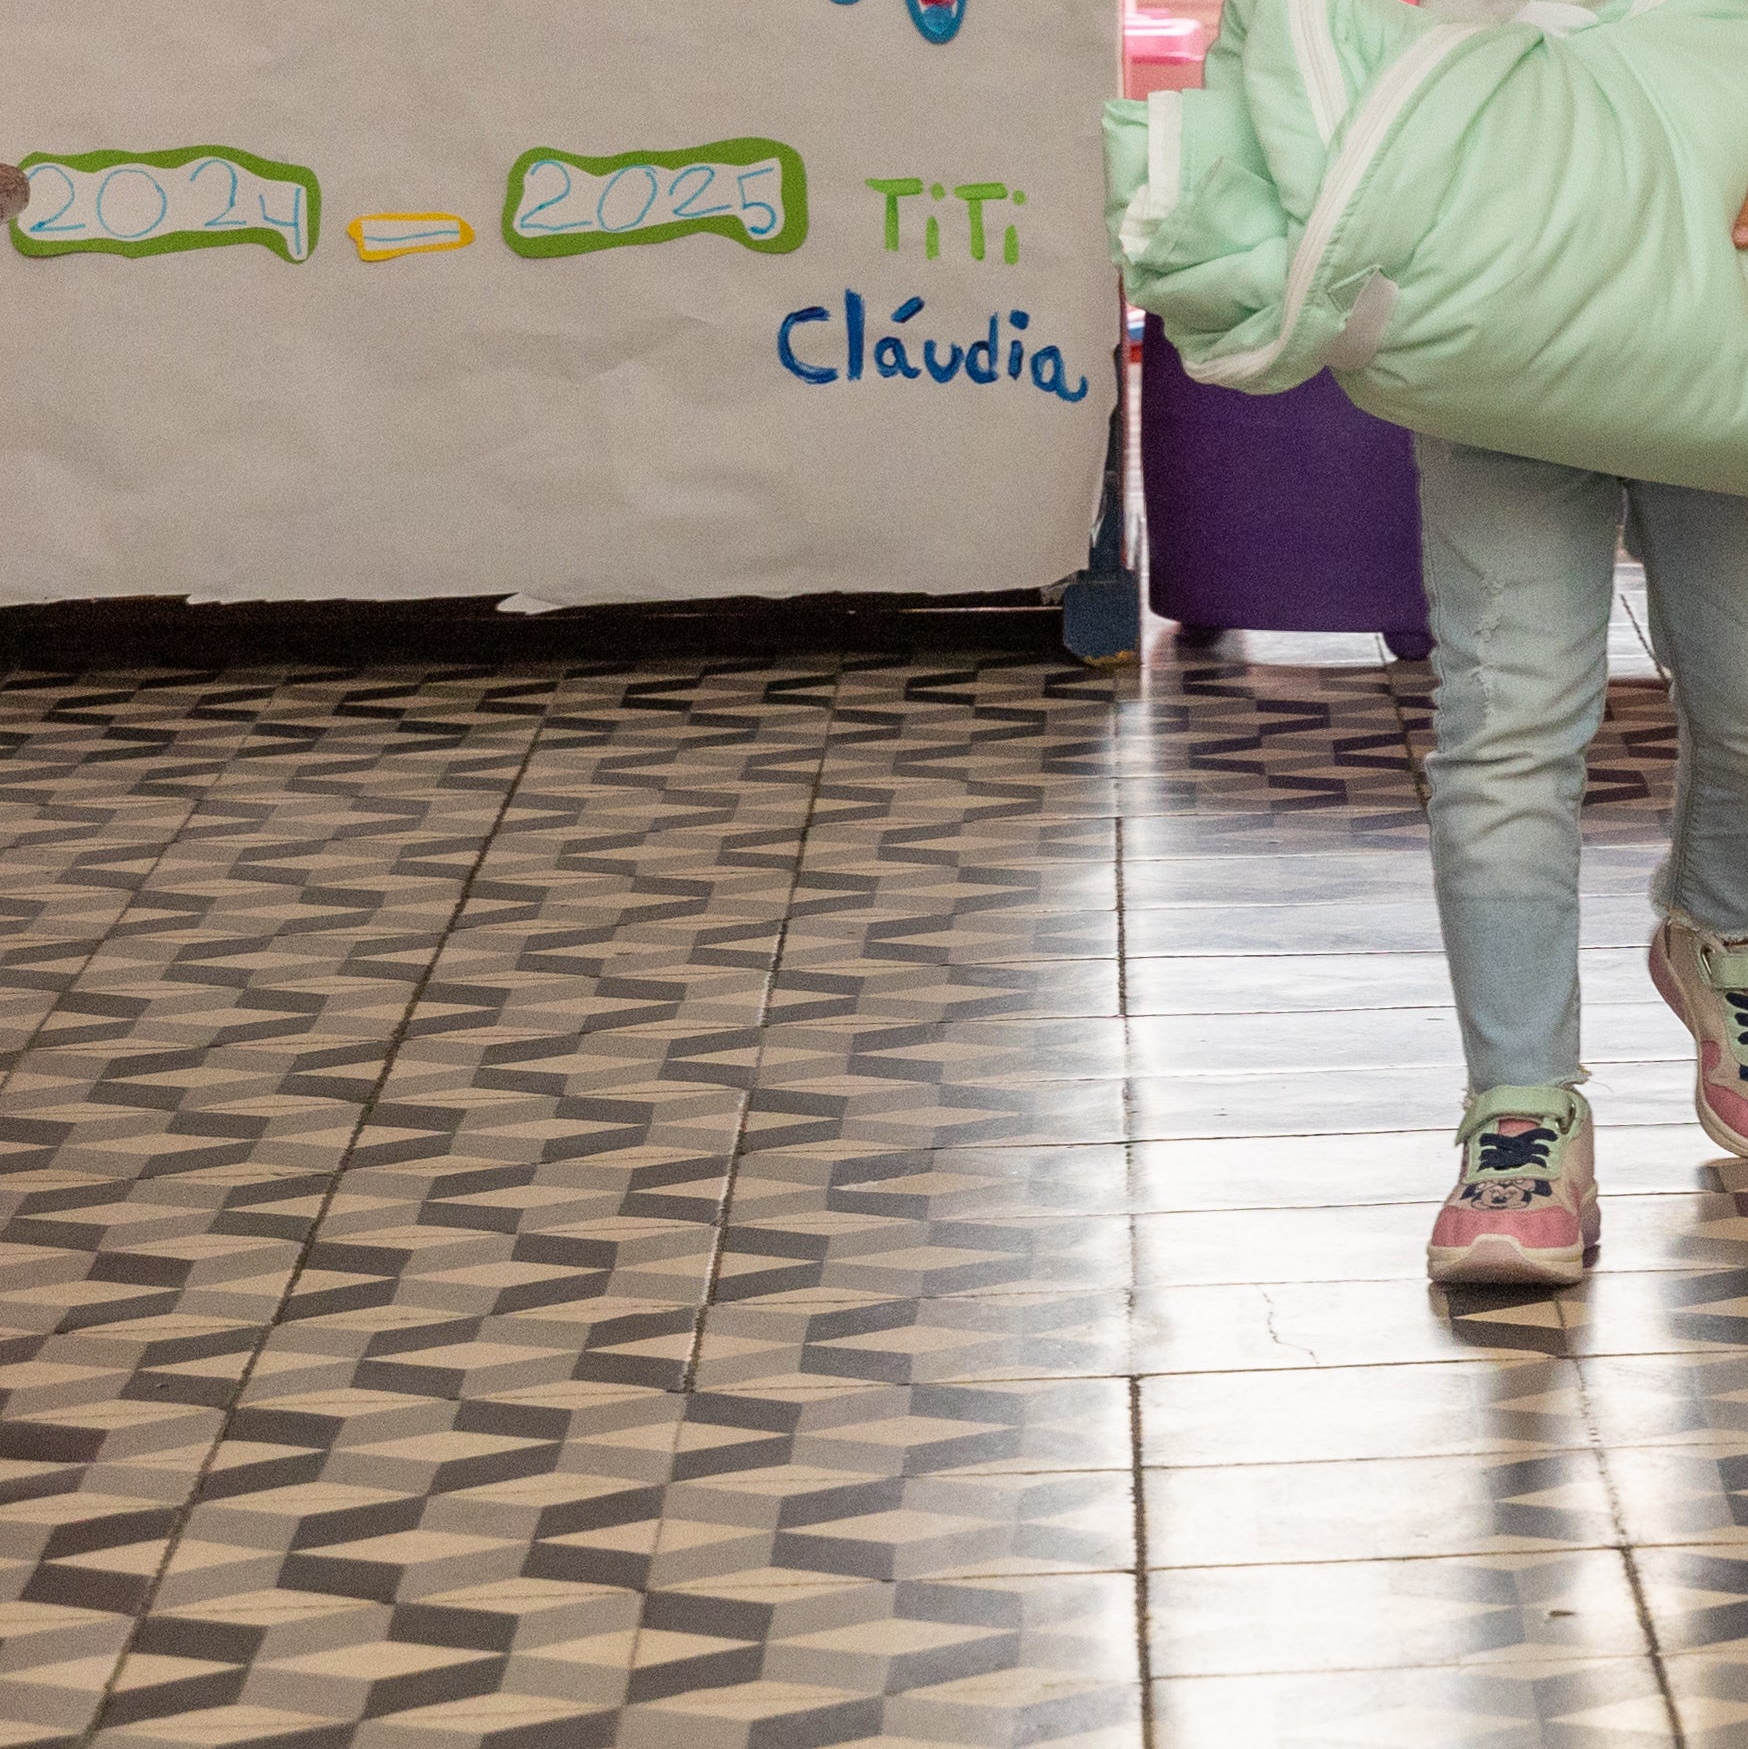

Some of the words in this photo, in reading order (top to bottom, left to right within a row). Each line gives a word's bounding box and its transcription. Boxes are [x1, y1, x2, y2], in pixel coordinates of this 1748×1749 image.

[27, 159, 303, 256] 2024
[519, 158, 778, 237] 2025
[776, 287, 1090, 403] Cláudia
